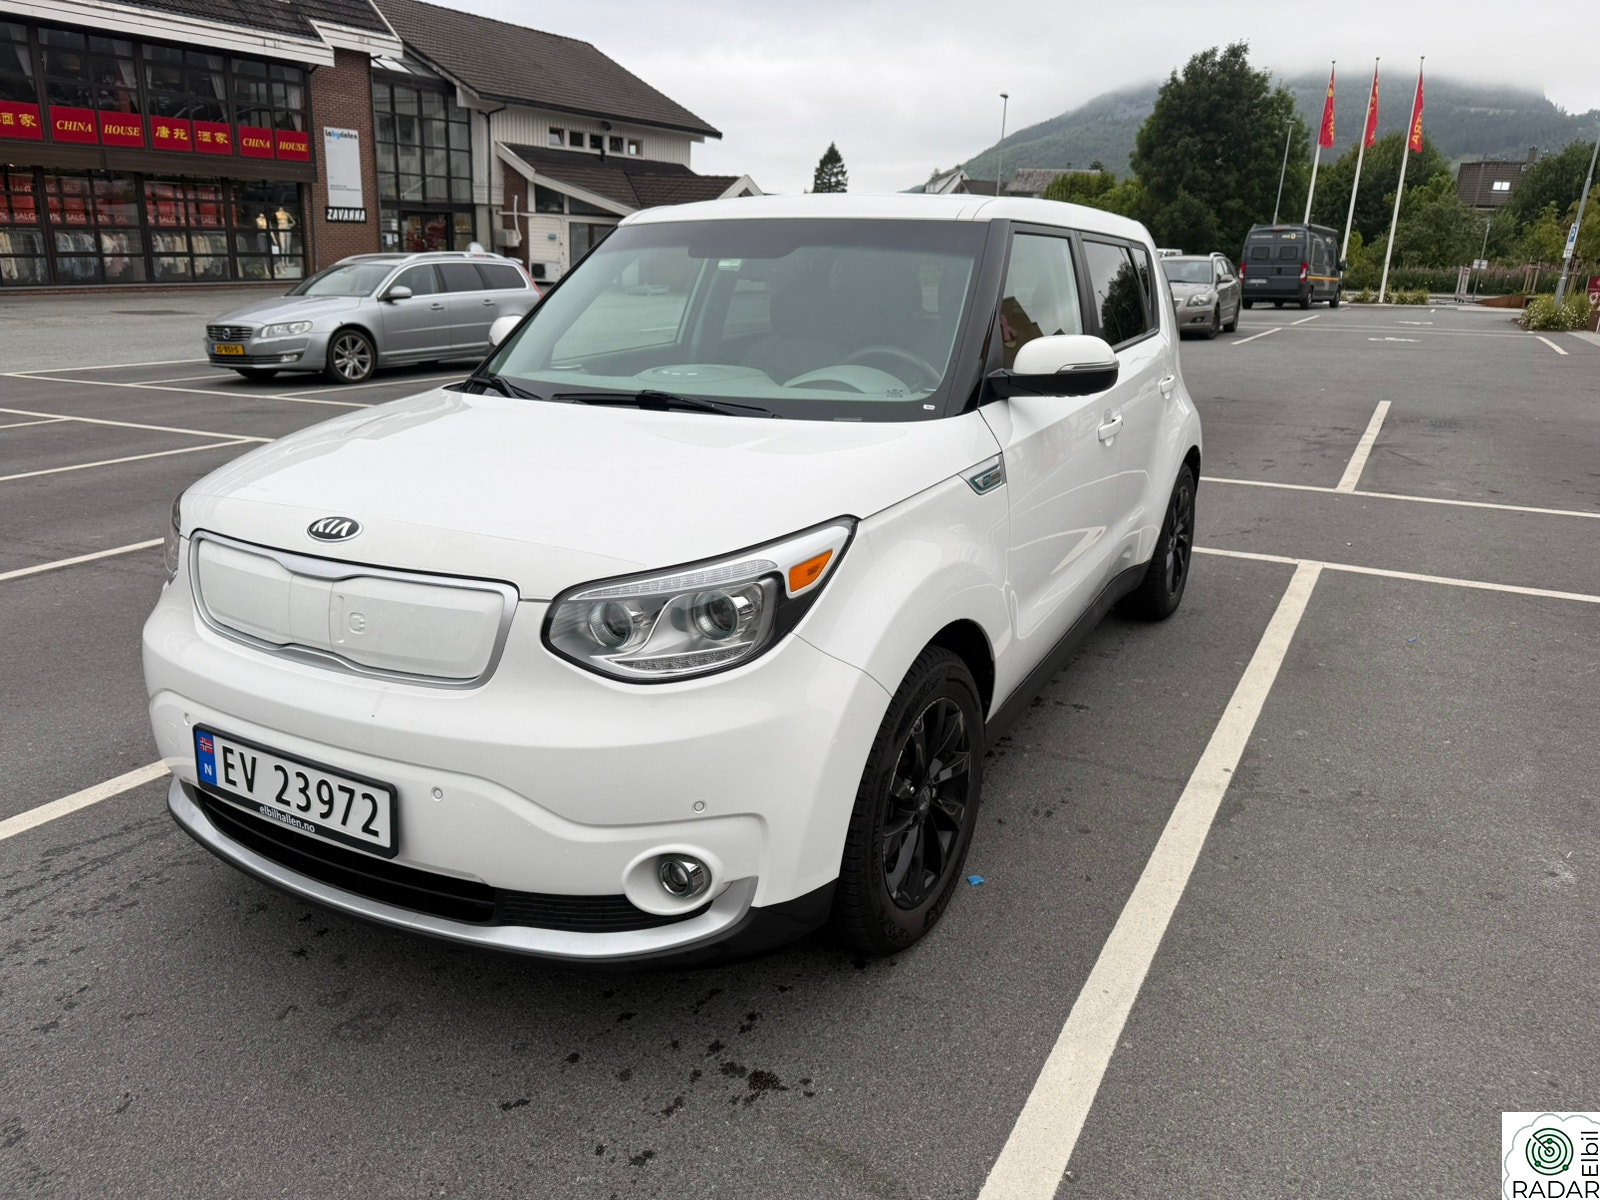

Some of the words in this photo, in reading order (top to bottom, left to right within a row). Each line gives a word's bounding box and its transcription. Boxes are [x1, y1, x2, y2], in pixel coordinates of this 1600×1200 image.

[56, 120, 92, 132] CHINA
[104, 124, 140, 137] HOUSE
[242, 137, 270, 149] CHINA
[279, 141, 307, 152] HOUSE
[14, 212, 36, 220] SALG
[66, 213, 86, 221] SALG
[327, 208, 366, 222] ZAVANNA
[312, 518, 352, 537] KIA
[204, 763, 212, 776] N
[222, 745, 257, 793] EV
[274, 764, 380, 838] 23972
[260, 805, 316, 833] elbilhallen.no
